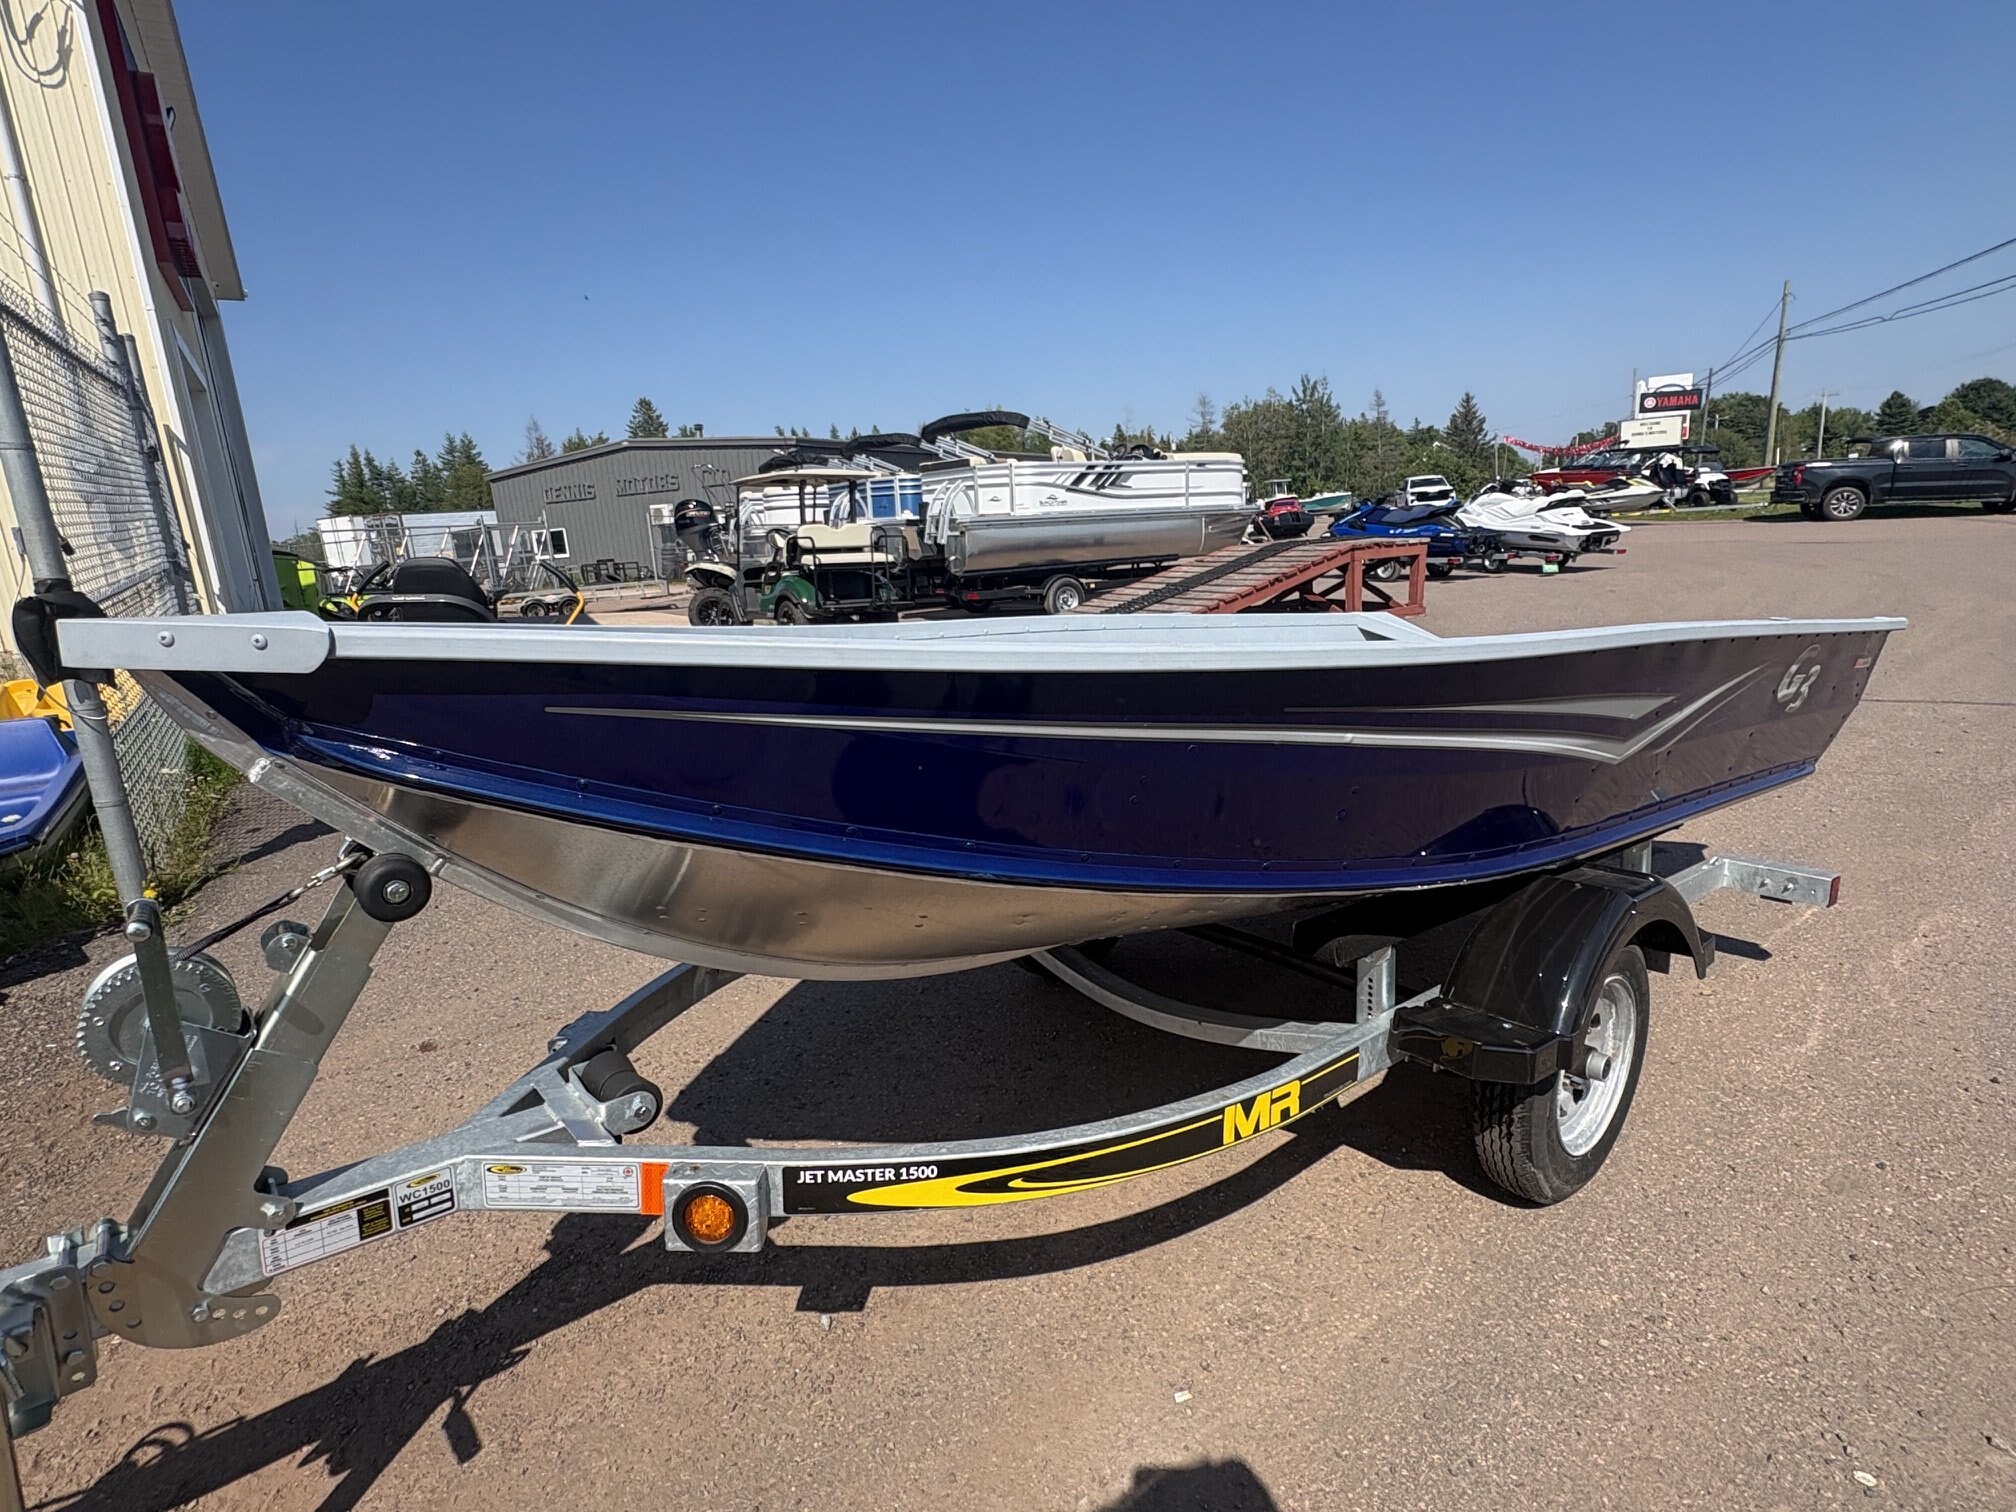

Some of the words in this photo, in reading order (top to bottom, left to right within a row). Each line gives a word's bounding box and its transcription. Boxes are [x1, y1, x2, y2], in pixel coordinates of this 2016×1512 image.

[1657, 395, 1698, 407] YAMAHA
[544, 483, 597, 505] DENNIS
[616, 473, 681, 498] MOTORS
[797, 1170, 825, 1184] JET
[828, 1167, 896, 1183] MASTER
[899, 1165, 938, 1181] 1500
[399, 1179, 450, 1203] WC1500
